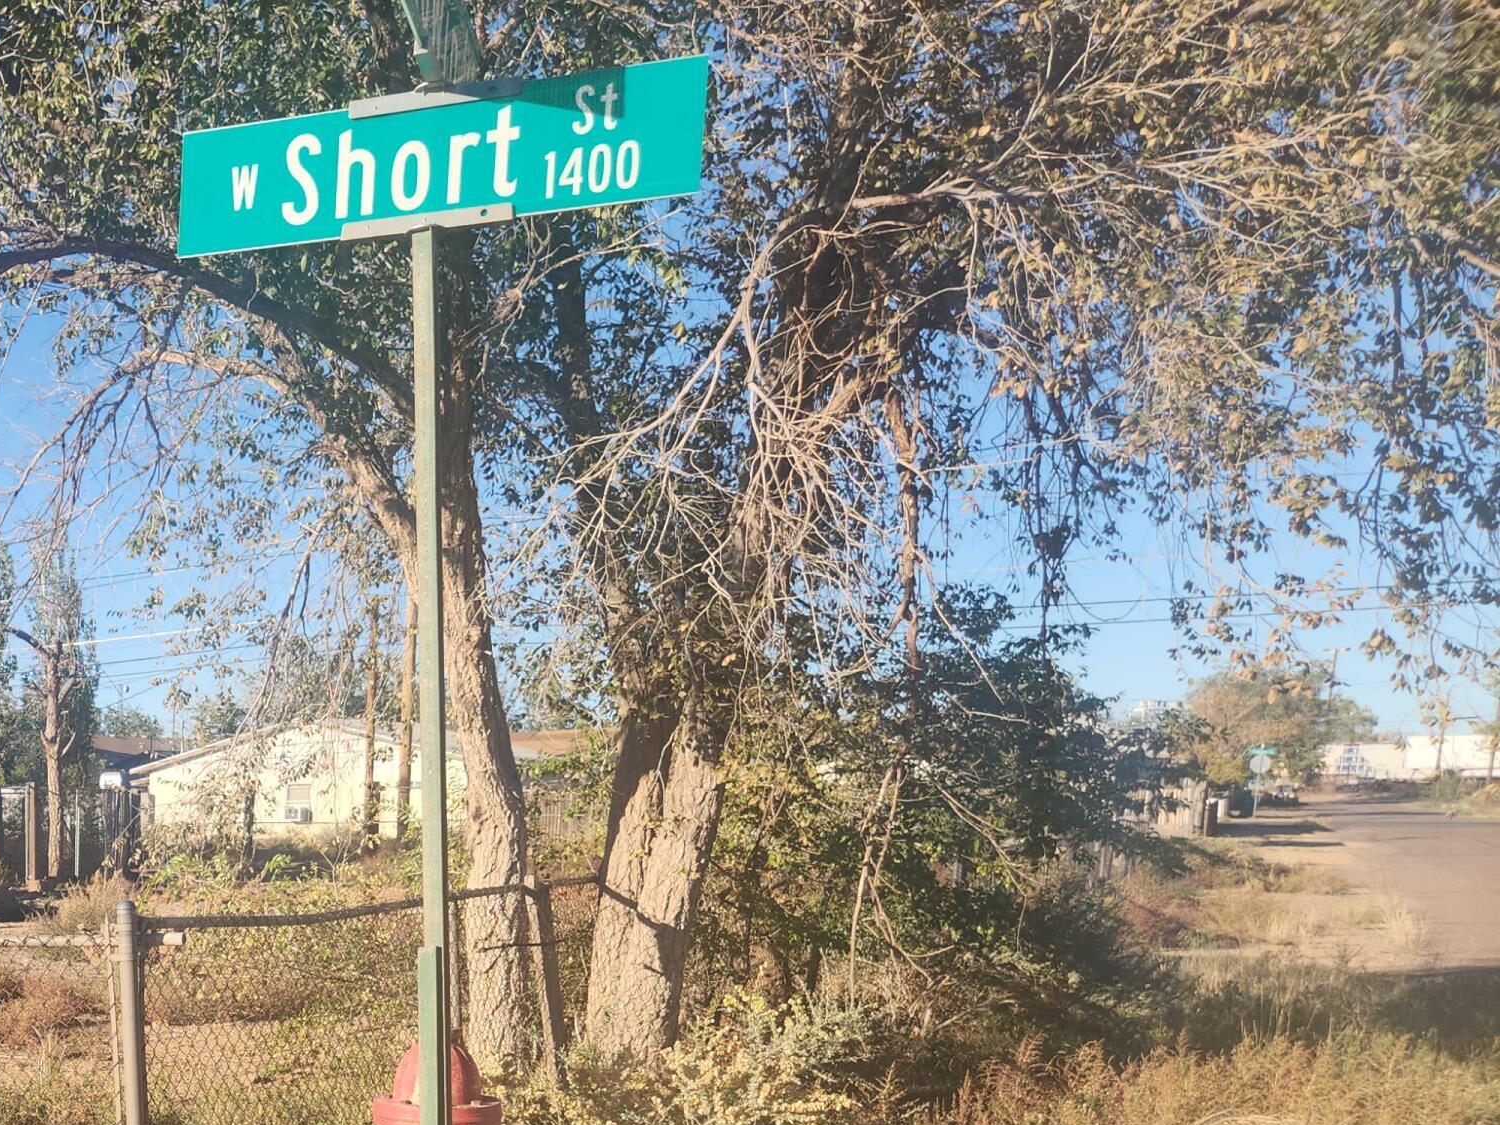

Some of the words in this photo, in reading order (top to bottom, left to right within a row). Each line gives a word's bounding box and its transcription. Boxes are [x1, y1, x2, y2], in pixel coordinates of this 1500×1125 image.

[231, 164, 259, 211] W
[281, 105, 520, 225] Short
[572, 83, 618, 135] St
[545, 140, 640, 198] 1400
